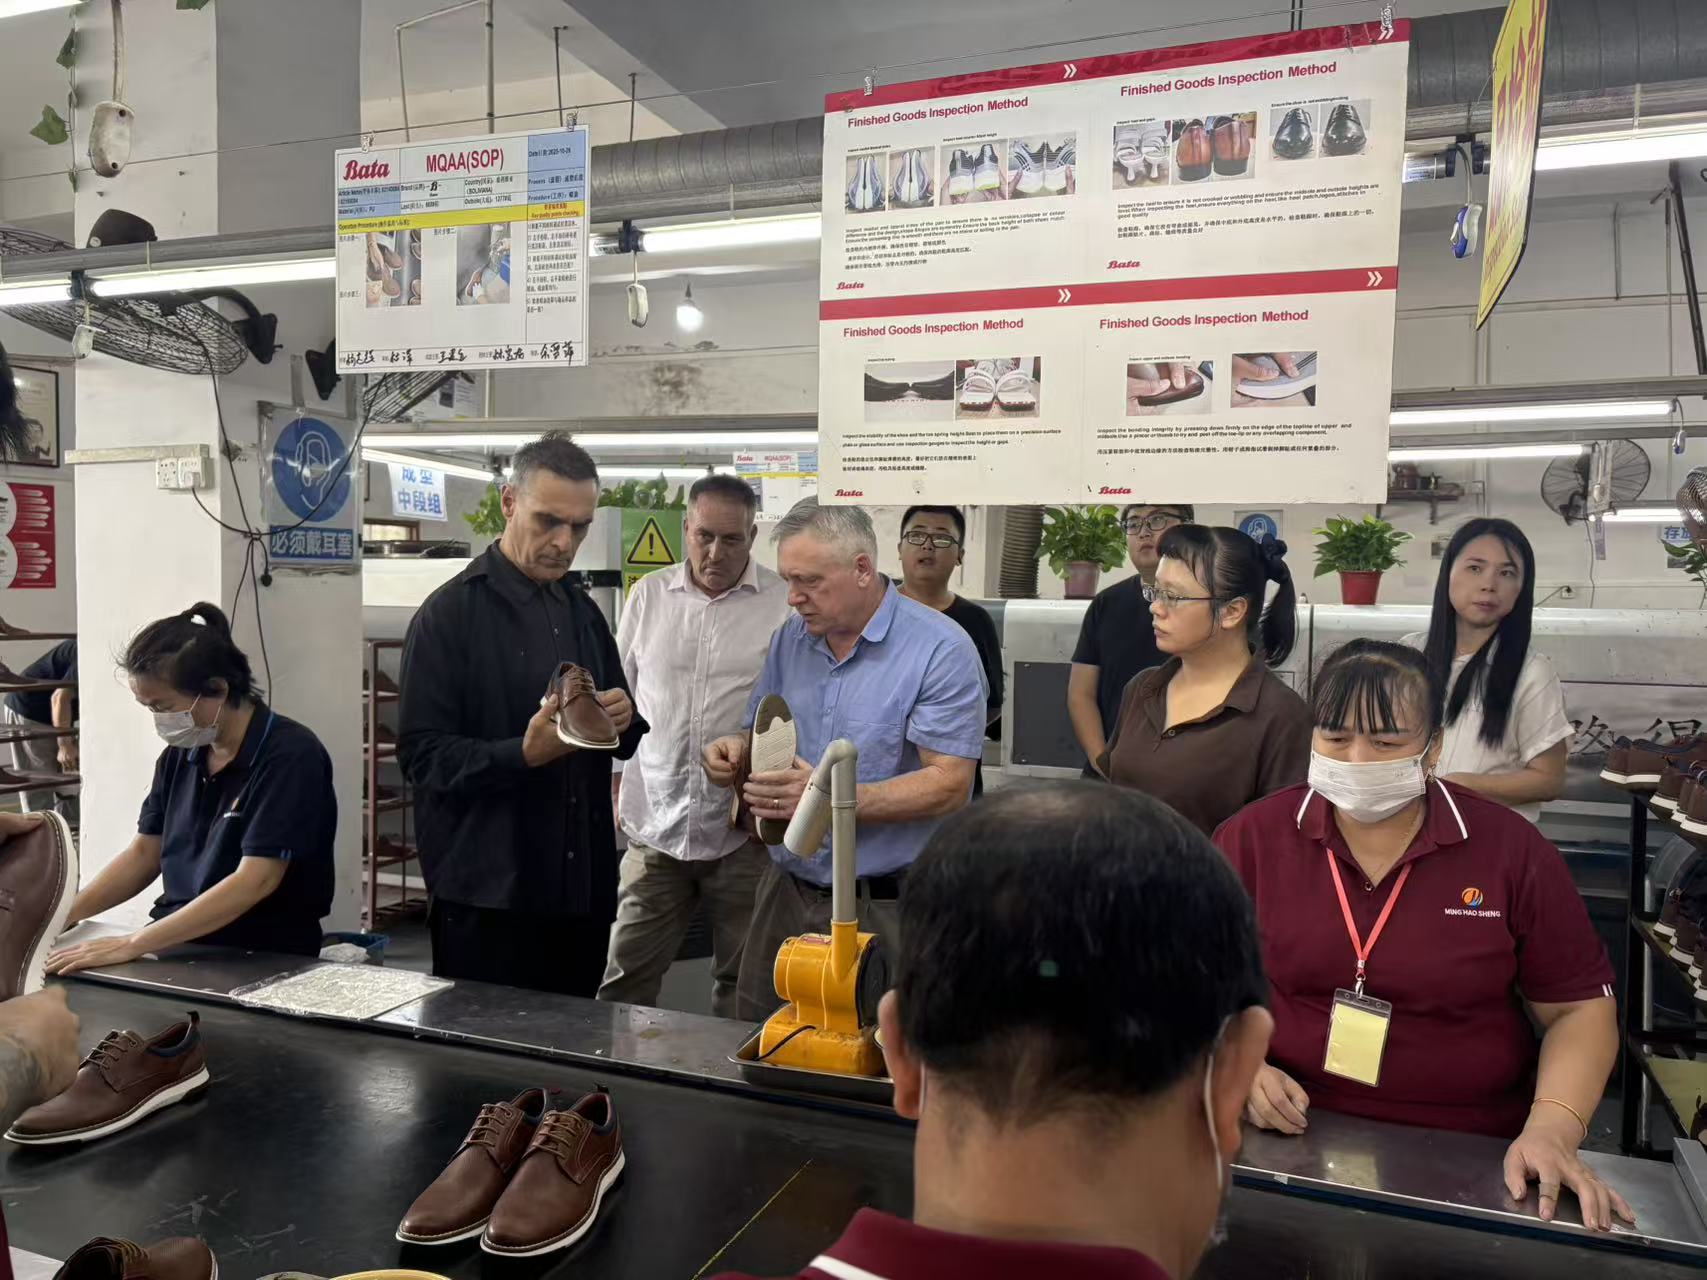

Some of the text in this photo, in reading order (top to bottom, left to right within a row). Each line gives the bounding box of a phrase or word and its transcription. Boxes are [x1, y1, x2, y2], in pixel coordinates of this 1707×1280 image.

[1121, 61, 1336, 96] Finished Goods Inspection Method
[848, 96, 1028, 128] Finished Goods Inspection Method
[343, 160, 390, 180] Bata
[426, 148, 504, 173] MQAA(SOP)
[1107, 259, 1140, 269] Bata
[836, 281, 864, 289] Bata
[844, 318, 1023, 337] Finished Goods Inspection Method
[1100, 310, 1308, 329] Finished Goods Inspection Method
[1099, 486, 1131, 494] Bata
[272, 530, 352, 556] 必须戴耳塞
